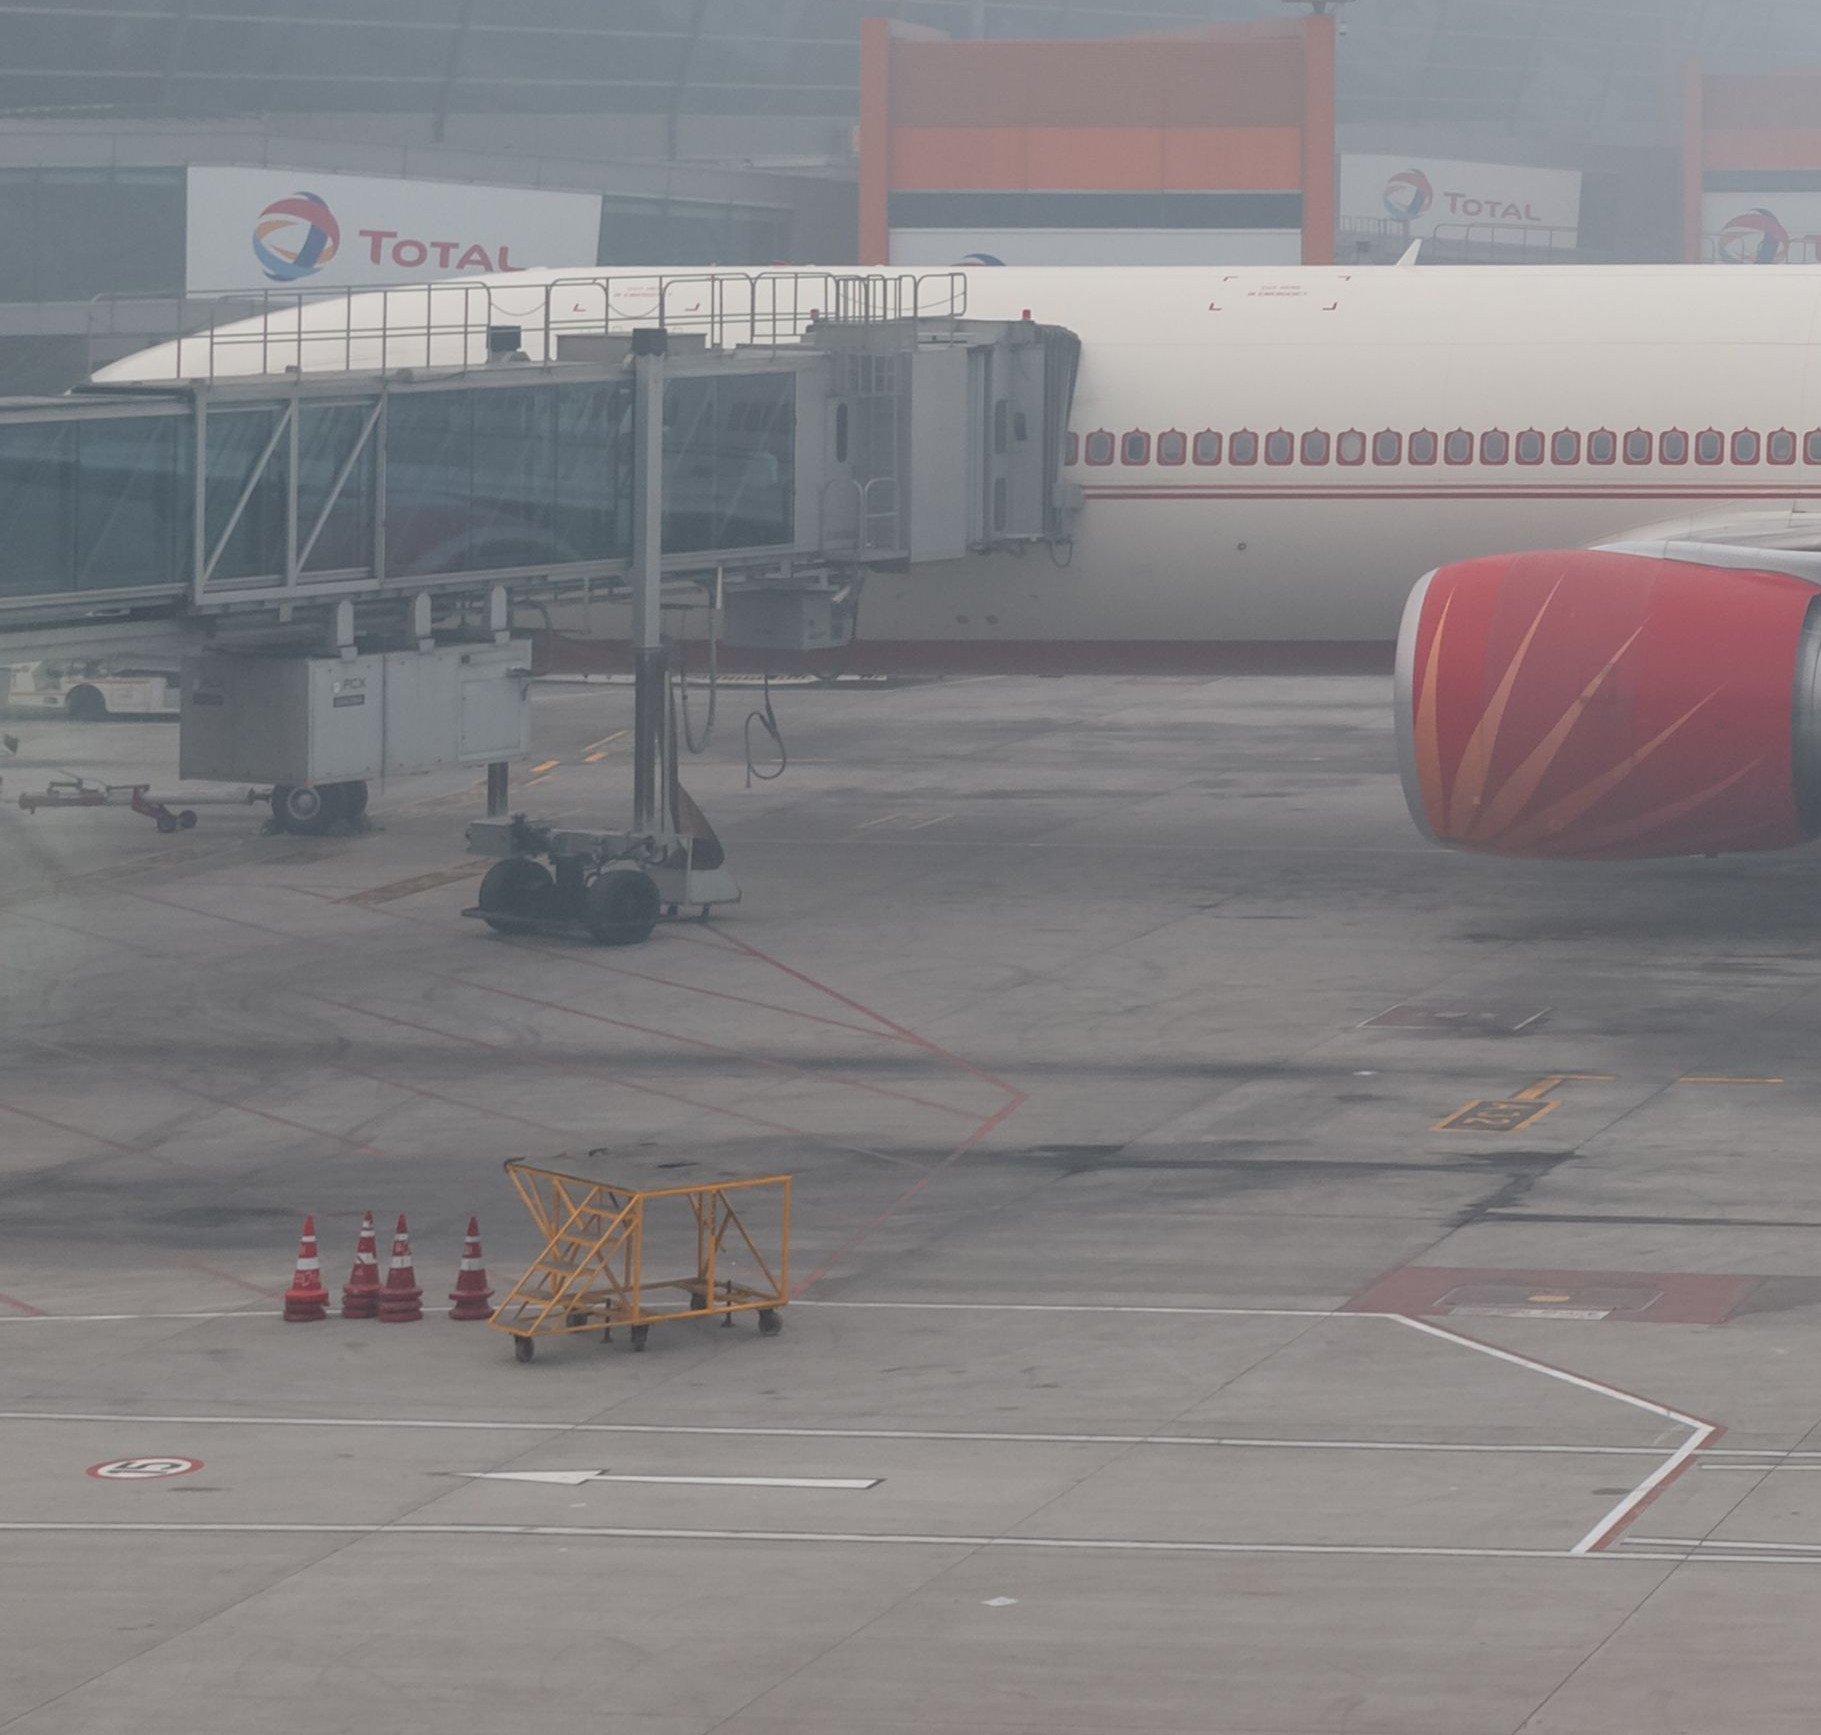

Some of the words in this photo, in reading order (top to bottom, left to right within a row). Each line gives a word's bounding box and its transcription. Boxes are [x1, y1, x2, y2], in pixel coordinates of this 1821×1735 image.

[1443, 192, 1542, 222] TOTAL
[358, 229, 528, 273] TOTAL
[106, 1461, 183, 1474] 15
